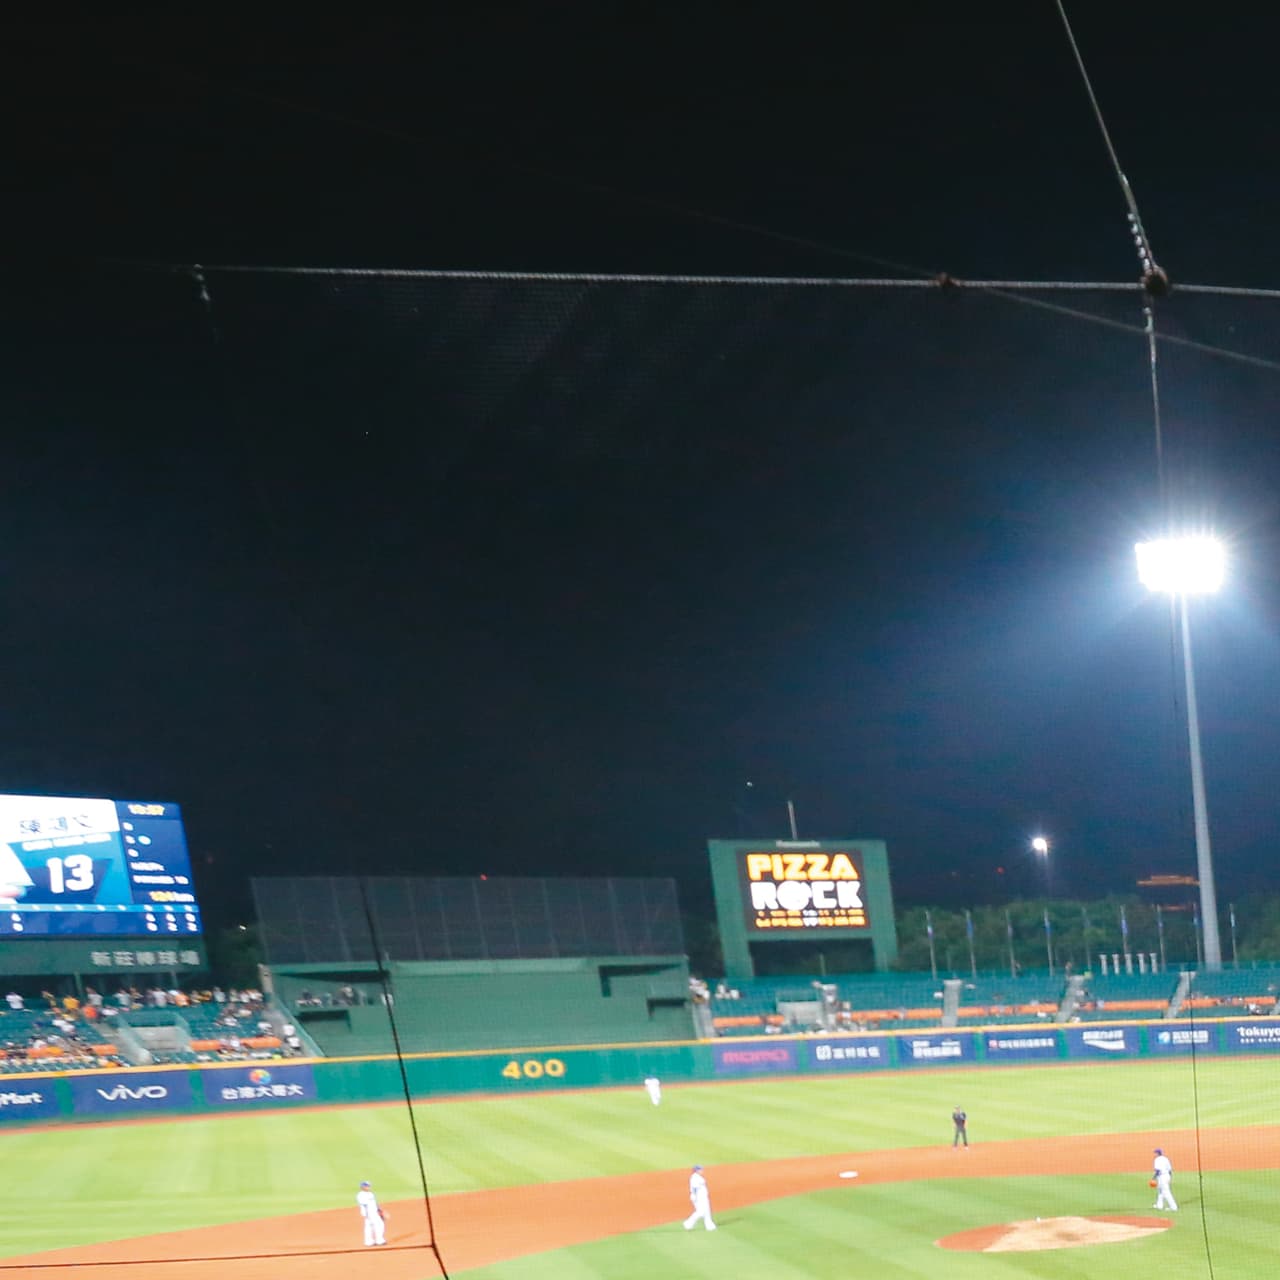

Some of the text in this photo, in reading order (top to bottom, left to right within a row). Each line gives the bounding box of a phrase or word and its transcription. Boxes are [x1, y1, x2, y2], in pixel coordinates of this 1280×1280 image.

[46, 854, 94, 894] 13
[747, 854, 858, 880] PIZZA
[750, 880, 863, 910] ROCK
[502, 1058, 566, 1080] 400
[97, 1084, 168, 1101] vivo
